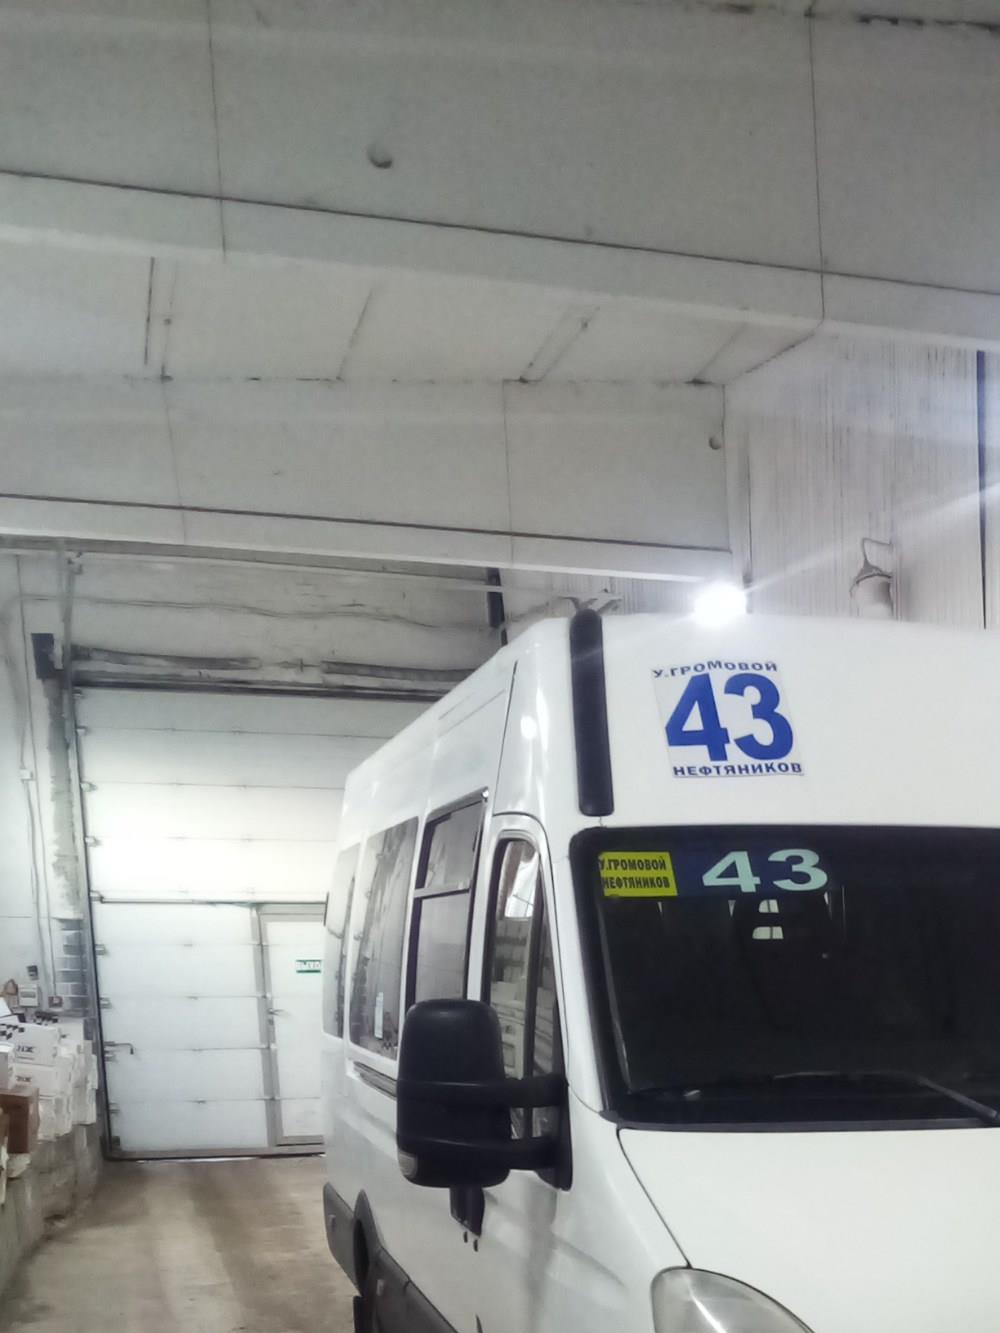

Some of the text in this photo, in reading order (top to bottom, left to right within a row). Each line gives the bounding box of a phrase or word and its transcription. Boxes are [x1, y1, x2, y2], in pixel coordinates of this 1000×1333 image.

[652, 660, 778, 678] У.ГРОМОВОЙ
[665, 672, 794, 761] 43
[673, 762, 802, 776] НЕФТЯНИКОВ
[702, 849, 828, 892] 43
